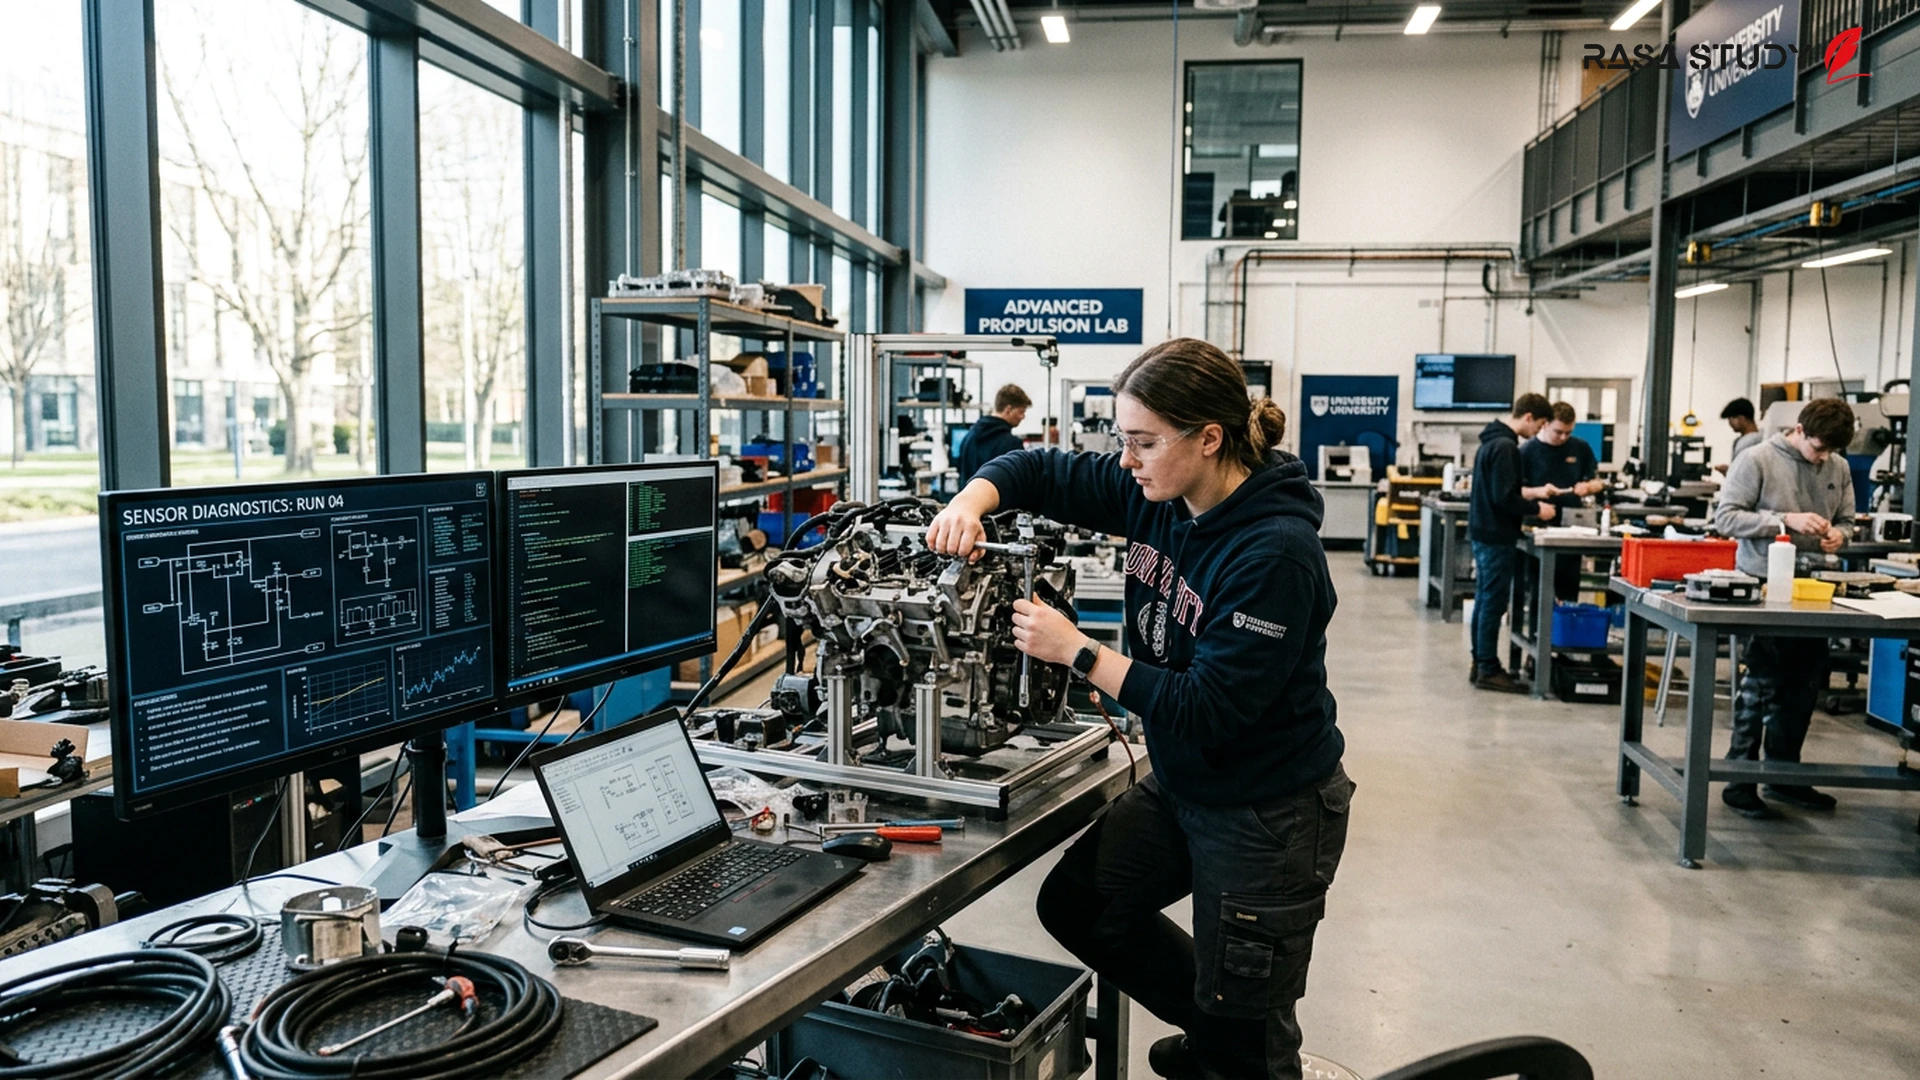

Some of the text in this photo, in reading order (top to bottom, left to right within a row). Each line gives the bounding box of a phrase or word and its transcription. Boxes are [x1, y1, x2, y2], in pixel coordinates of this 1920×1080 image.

[1003, 299, 1104, 315] ADVANCED
[979, 317, 1129, 334] PROPULSION LAB
[123, 494, 345, 526] SENSOR DIAGNOSTICS: RUN 04
